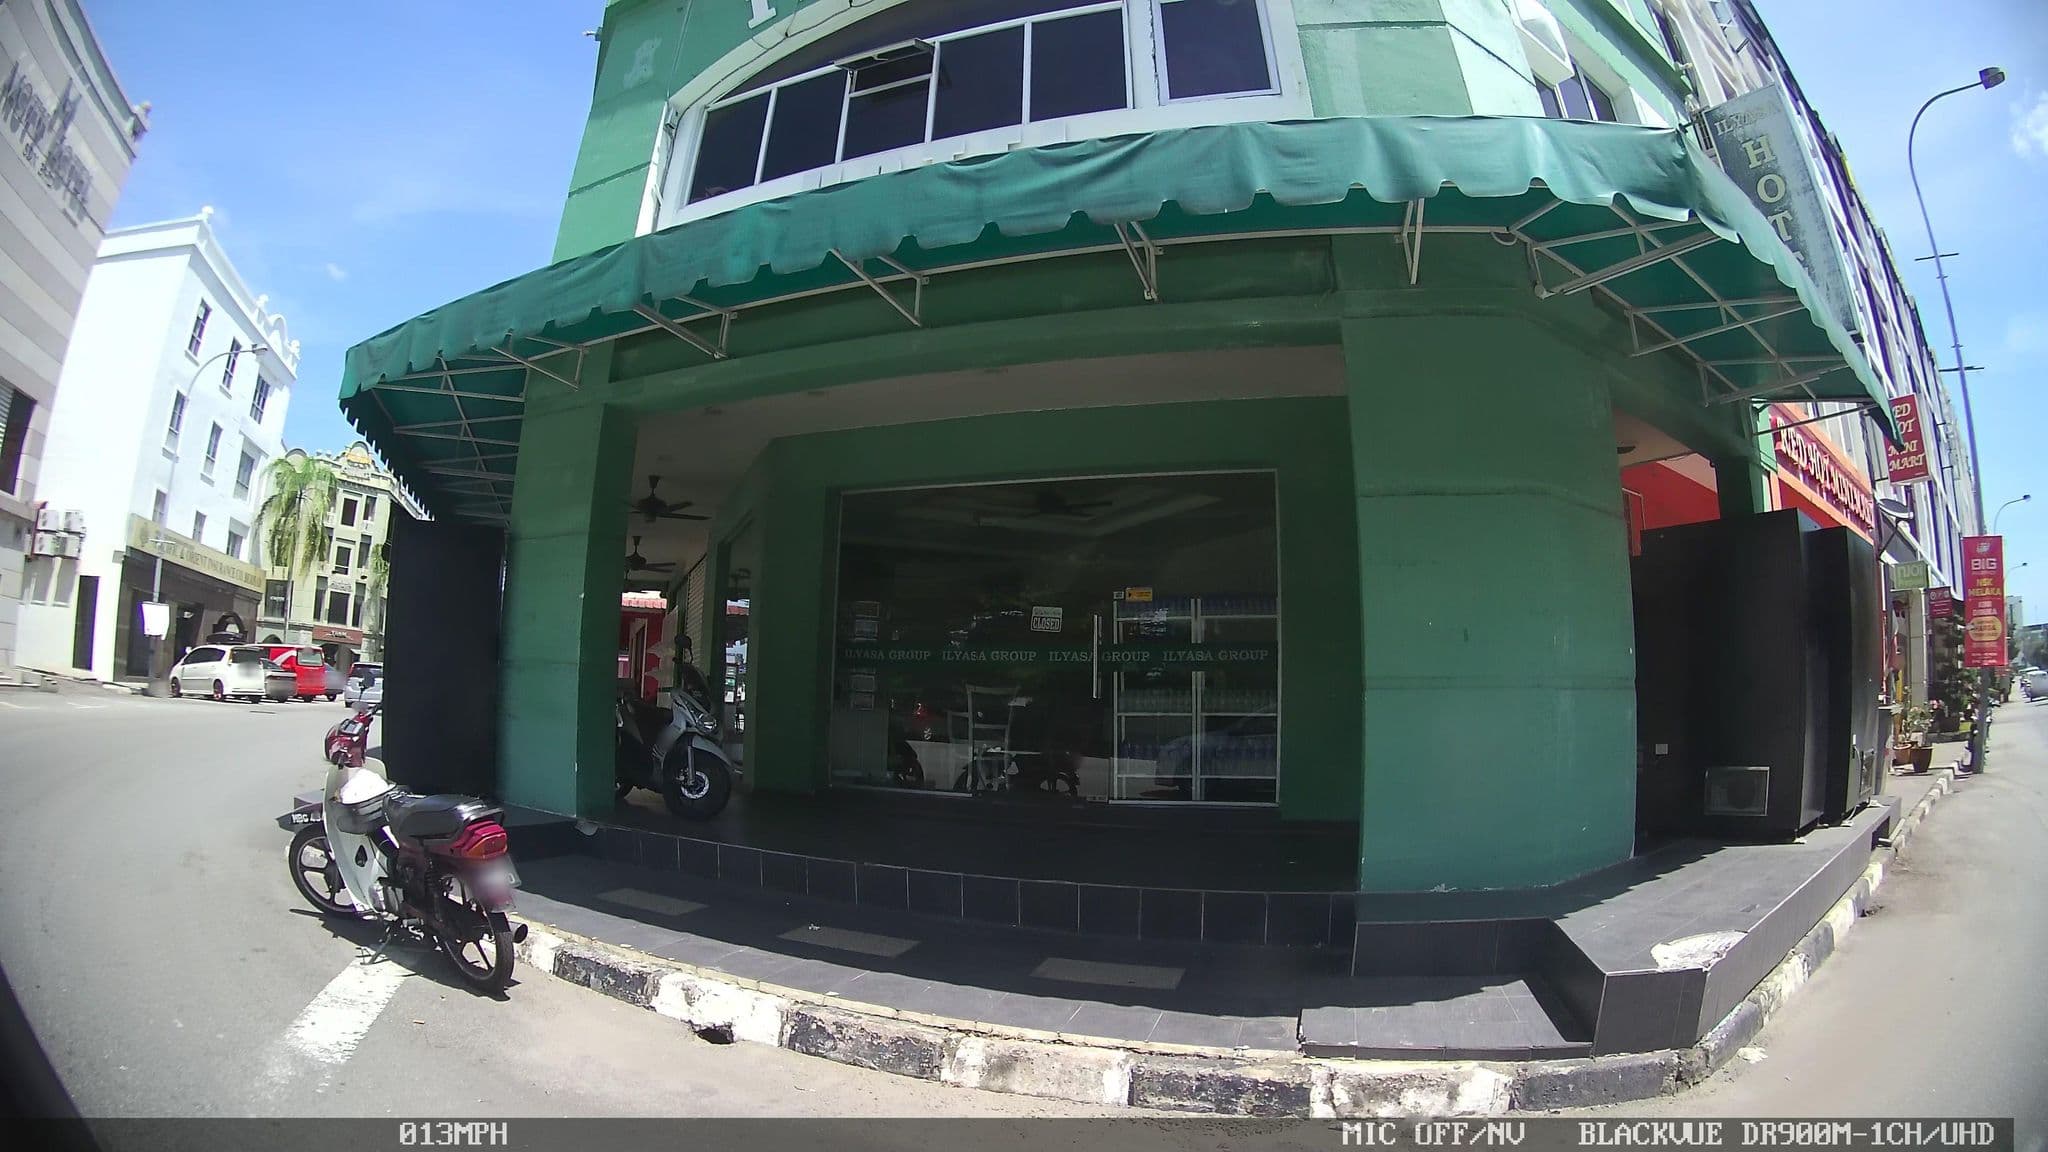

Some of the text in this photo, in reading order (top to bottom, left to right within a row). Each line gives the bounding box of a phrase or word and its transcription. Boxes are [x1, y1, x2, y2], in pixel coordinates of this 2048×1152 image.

[1743, 135, 1807, 276] HOT
[1892, 403, 1912, 417] ED
[1896, 418, 1917, 434] OT
[1888, 454, 1926, 473] MART
[1971, 557, 1998, 571] BIG
[1032, 617, 1060, 631] CLOSED
[844, 649, 931, 661] ILYASA GROUP
[942, 649, 1037, 662] ILYASA GROUP
[1102, 651, 1151, 663] GROUP
[1161, 649, 1269, 662] ILYASA GROUP
